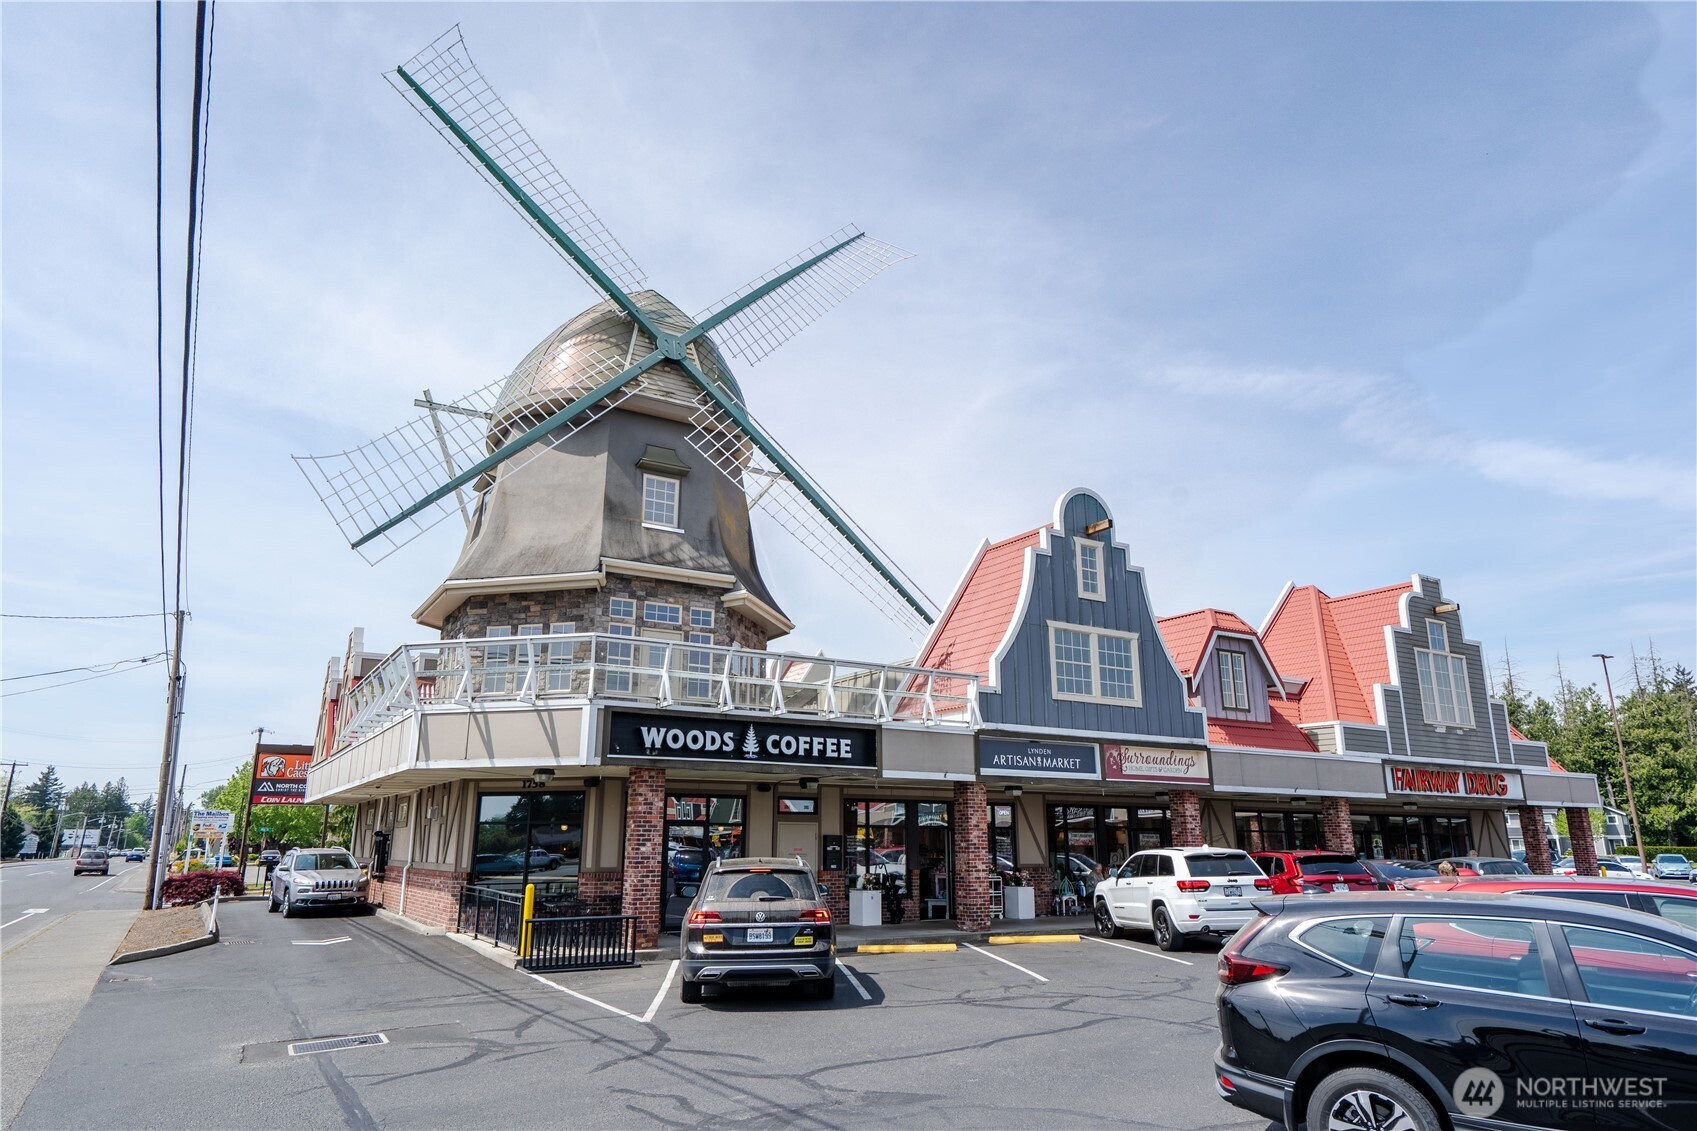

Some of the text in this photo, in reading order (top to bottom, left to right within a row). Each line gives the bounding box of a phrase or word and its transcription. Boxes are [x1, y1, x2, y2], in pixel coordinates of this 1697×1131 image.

[640, 726, 852, 758] WOODS COFFEE
[993, 755, 1081, 769] ARTISAN MARKET
[1118, 748, 1197, 774] Surroundings
[1391, 767, 1508, 797] FAIRWAY DRUG
